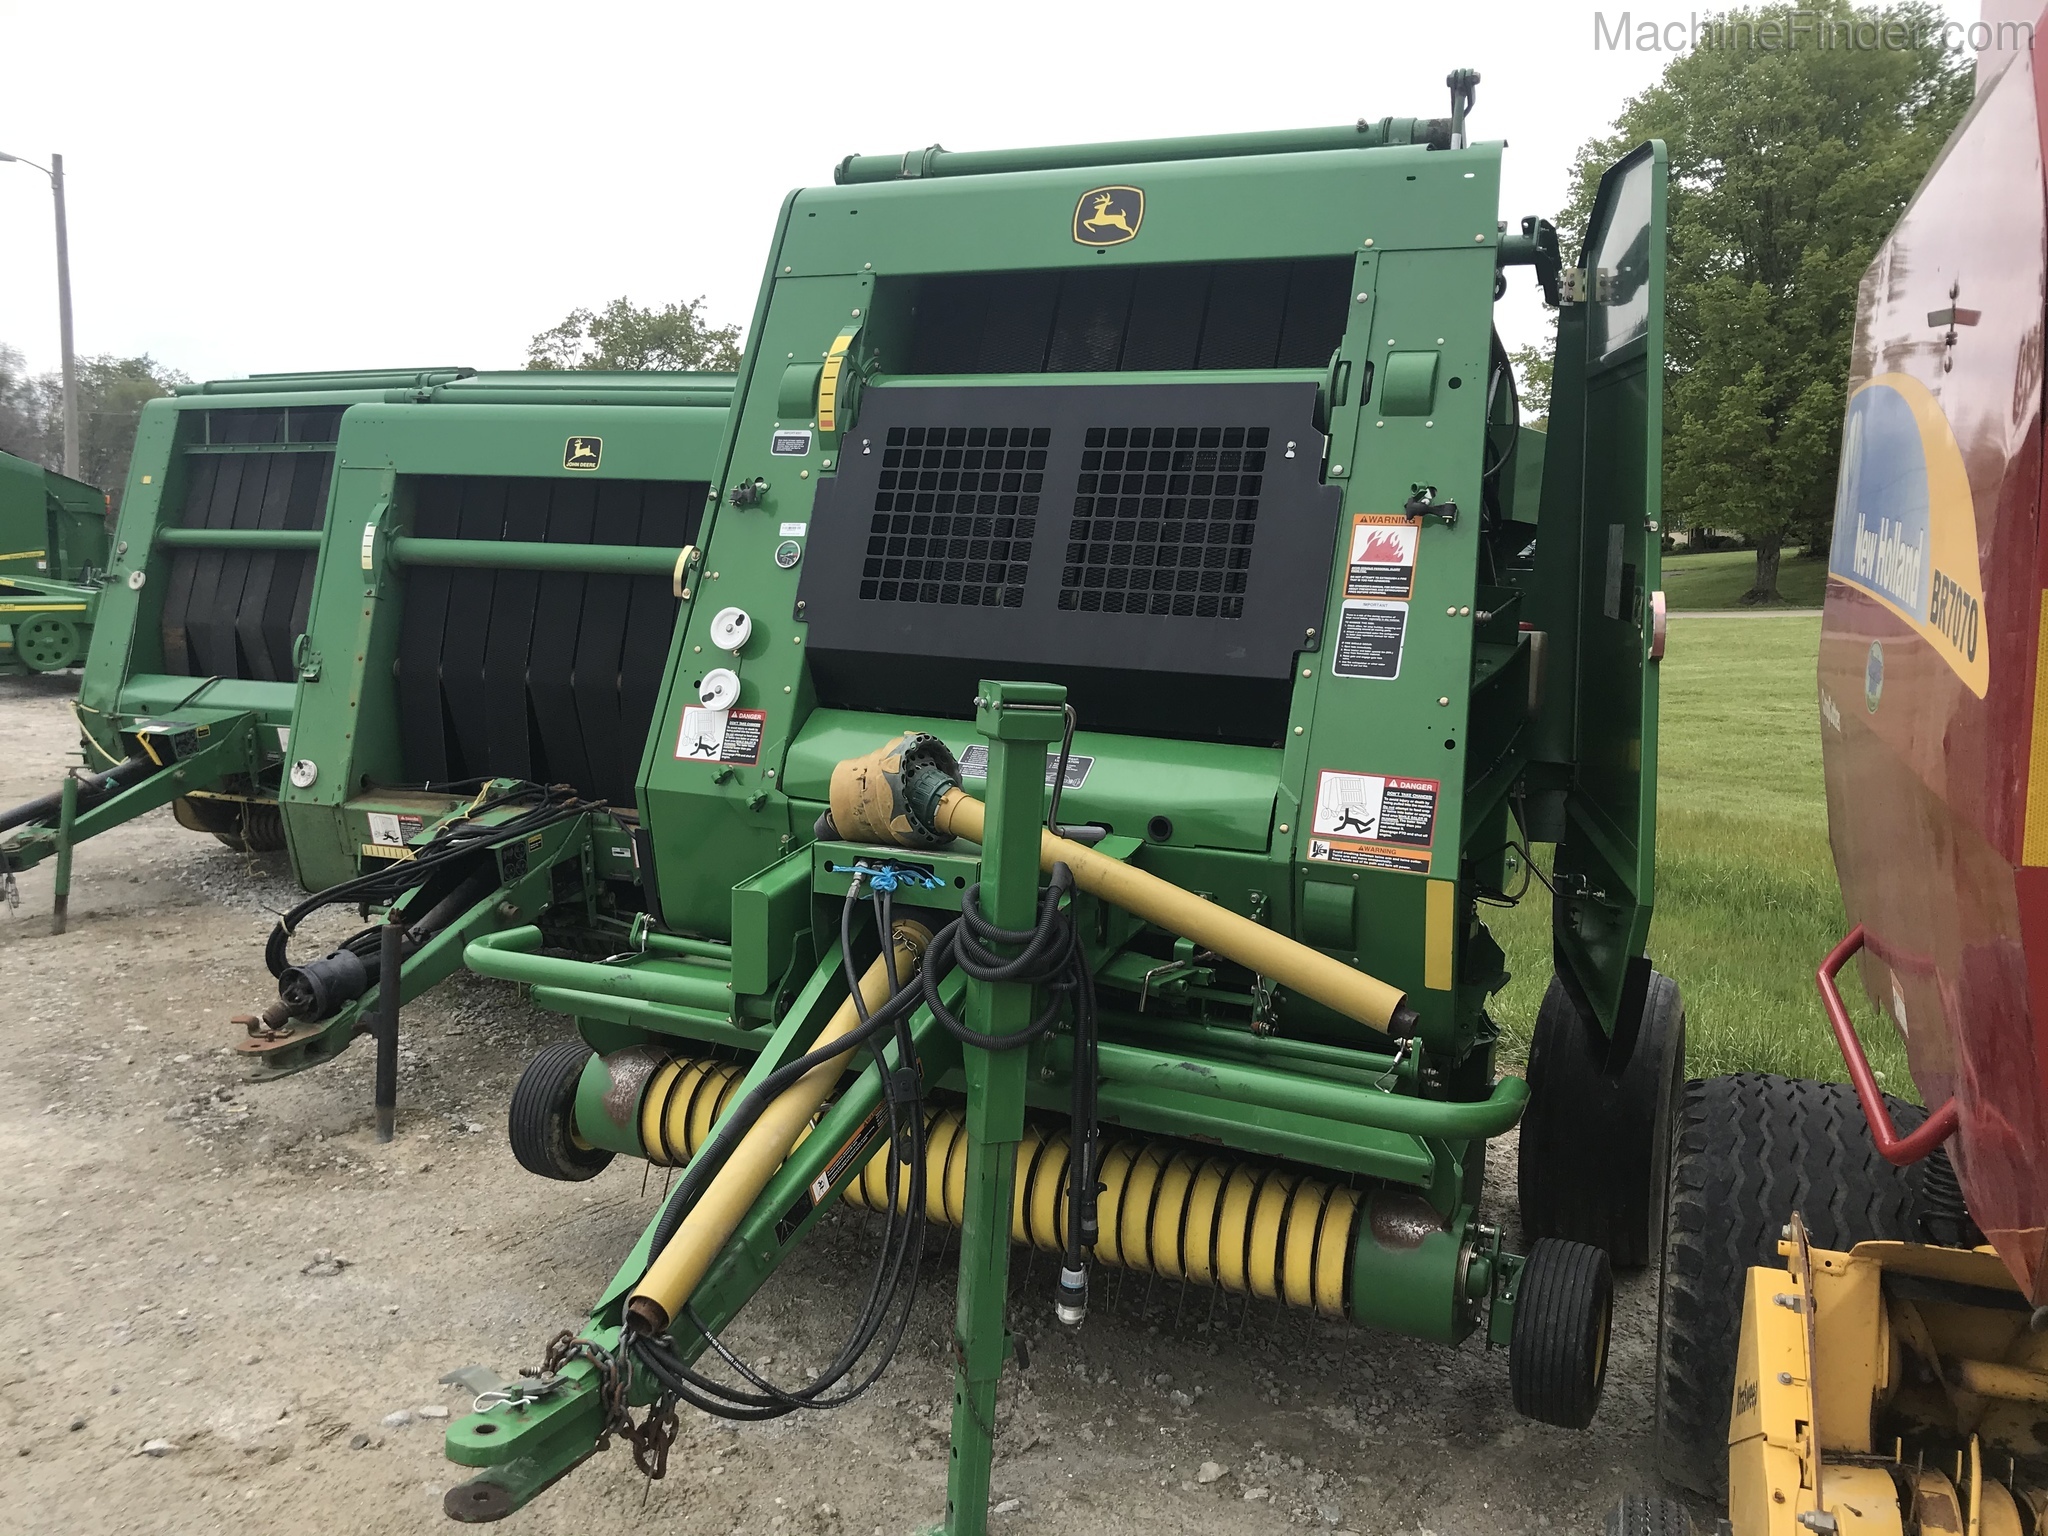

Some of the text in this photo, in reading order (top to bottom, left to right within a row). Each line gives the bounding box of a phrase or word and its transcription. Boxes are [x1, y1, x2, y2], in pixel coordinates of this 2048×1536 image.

[1368, 516, 1416, 524] WARNING
[1853, 512, 1924, 610] New Holland
[1930, 568, 1978, 664] BR7070
[1400, 782, 1432, 791] DANGER
[1364, 846, 1396, 854] WARNING
